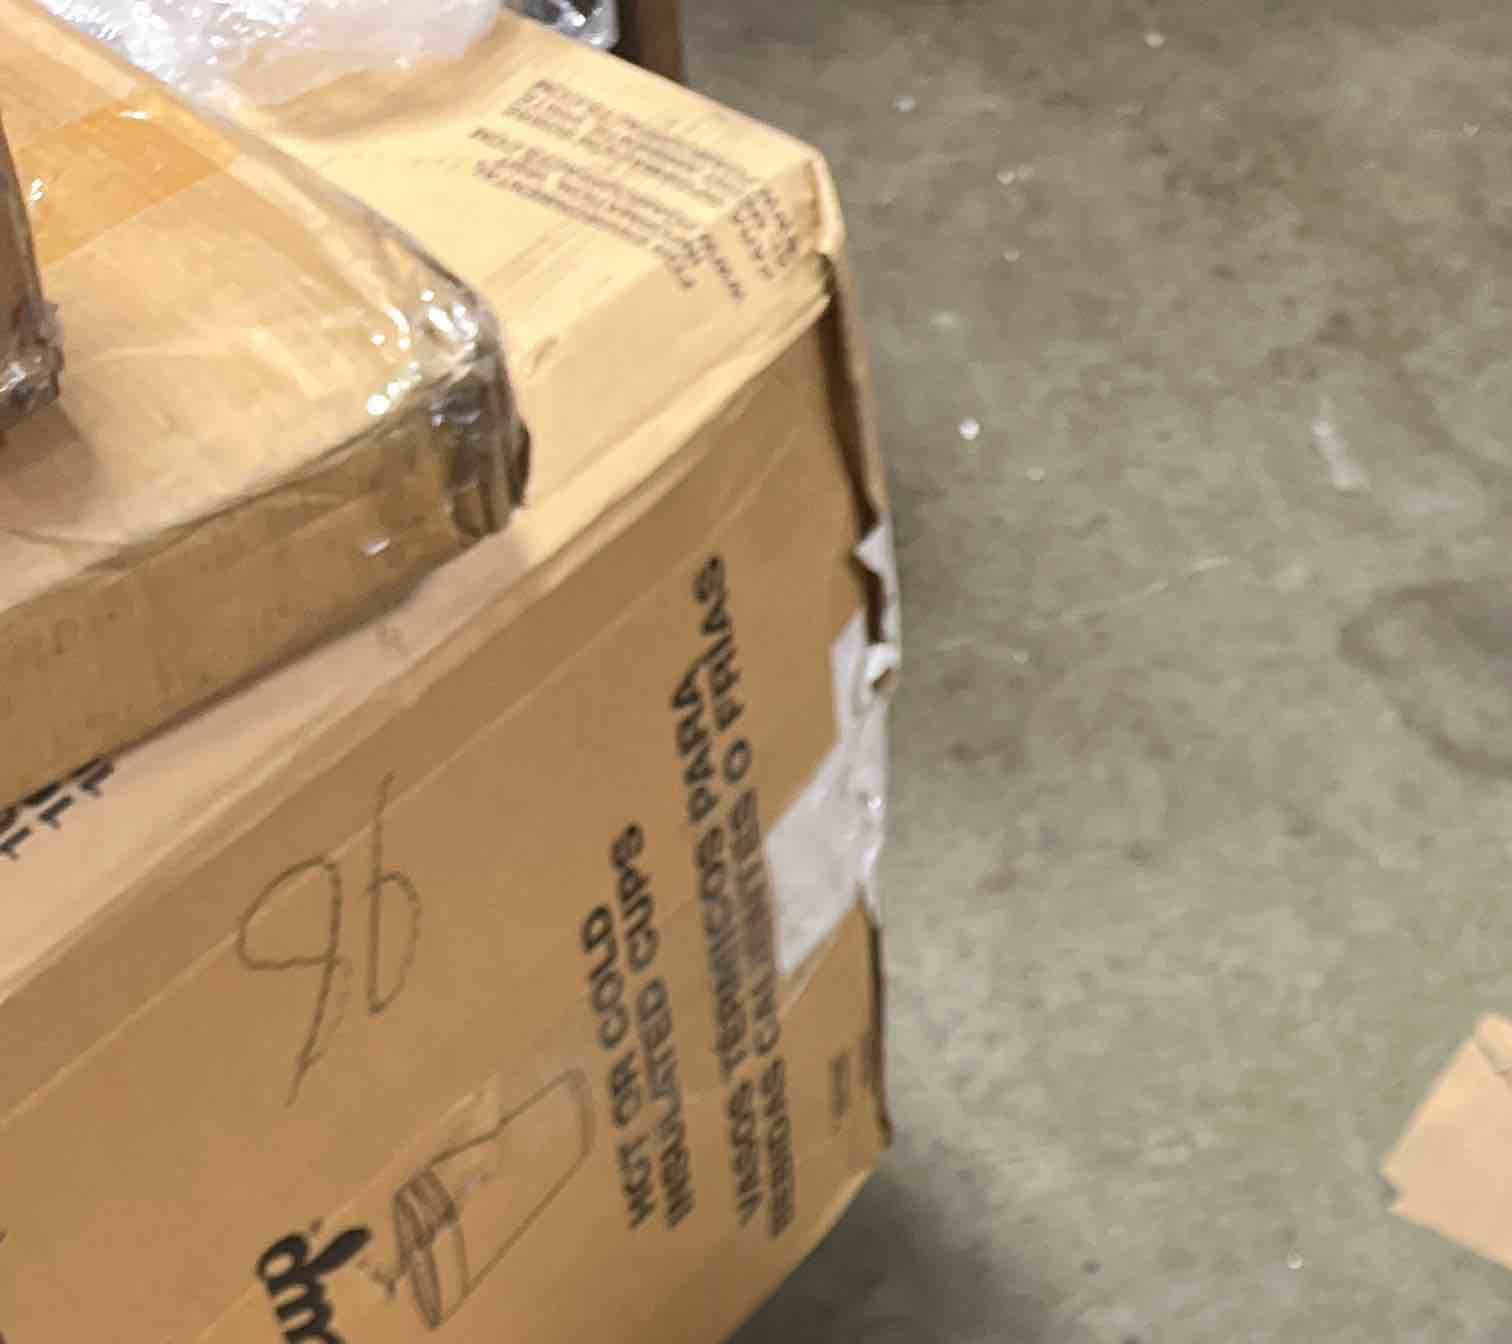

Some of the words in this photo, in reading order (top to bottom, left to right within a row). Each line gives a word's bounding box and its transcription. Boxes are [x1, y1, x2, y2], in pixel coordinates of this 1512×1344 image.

[671, 660, 721, 826] PARA
[722, 736, 752, 784] O
[610, 823, 658, 973] CUPS
[583, 904, 629, 1050] COLD
[609, 1048, 642, 1129] OR
[636, 976, 697, 1231] INSULATED
[727, 1078, 763, 1227] VASOS
[618, 1133, 656, 1231] HOT
